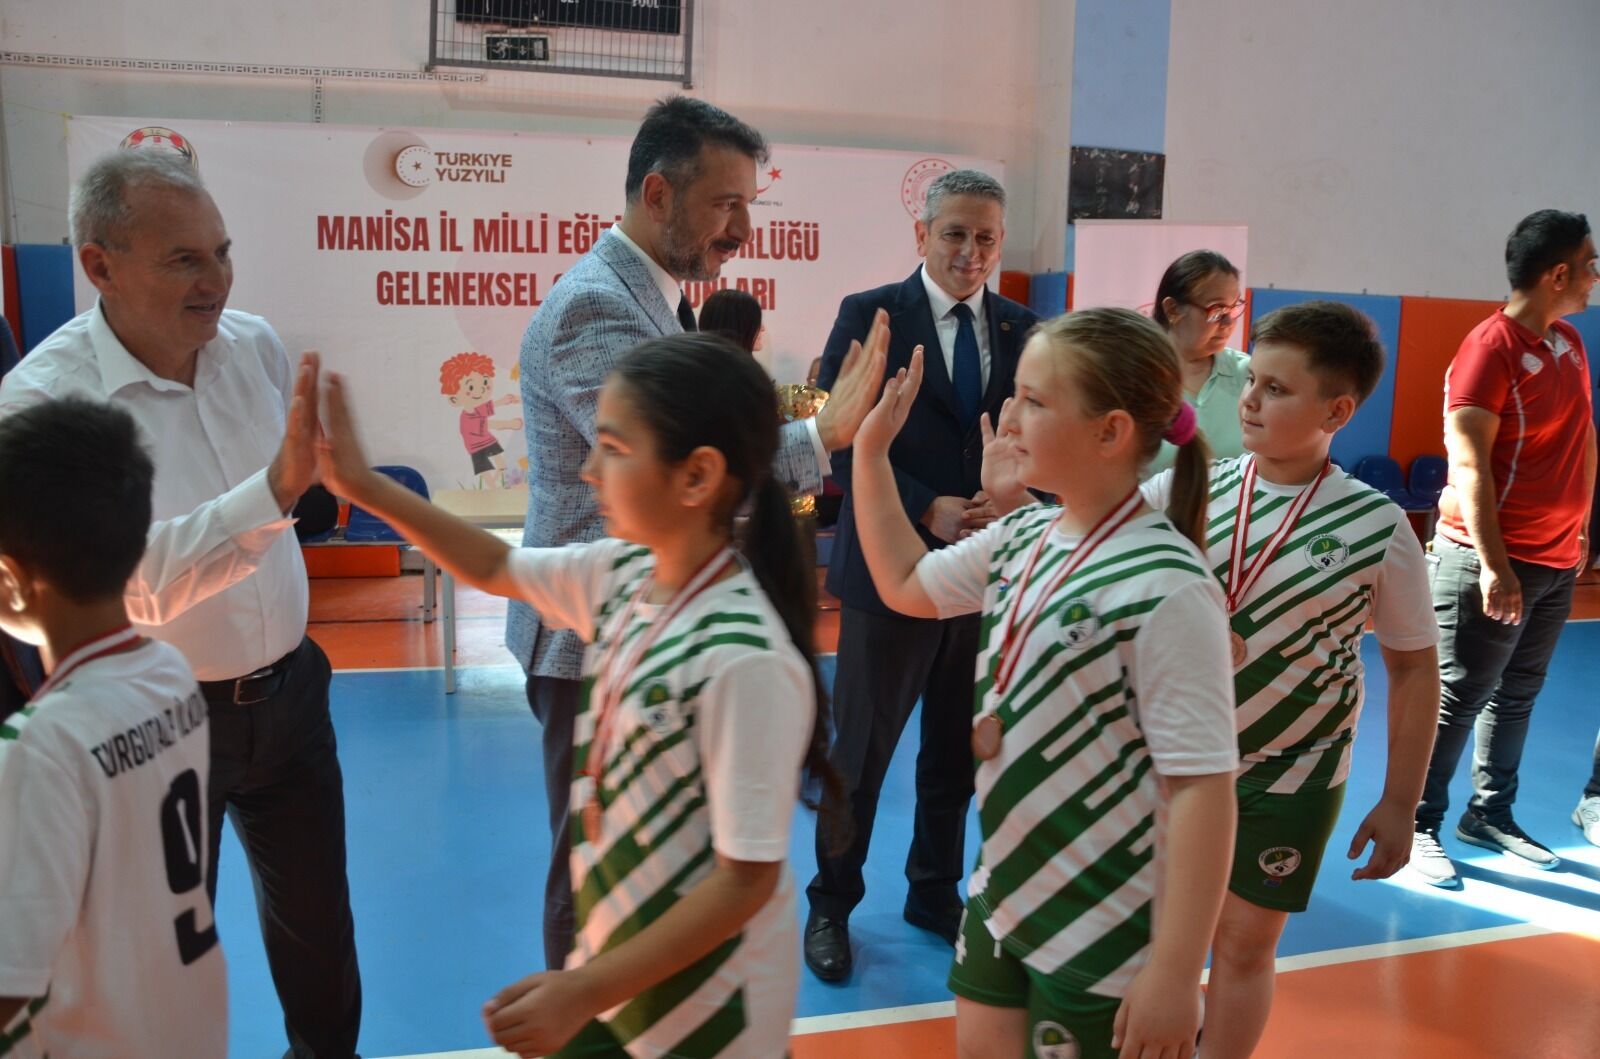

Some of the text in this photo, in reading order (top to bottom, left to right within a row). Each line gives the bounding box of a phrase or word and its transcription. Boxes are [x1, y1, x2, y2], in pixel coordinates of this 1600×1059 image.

[434, 152, 512, 168] TÜRKİYE
[435, 168, 505, 183] YÜZYILI
[317, 209, 430, 251] MANİSA
[440, 210, 464, 252] İL
[473, 212, 548, 253] MİLLİ
[730, 221, 820, 261] RLÜĞÜ
[376, 271, 543, 306] GELENEKSEL
[161, 768, 219, 966] 9
